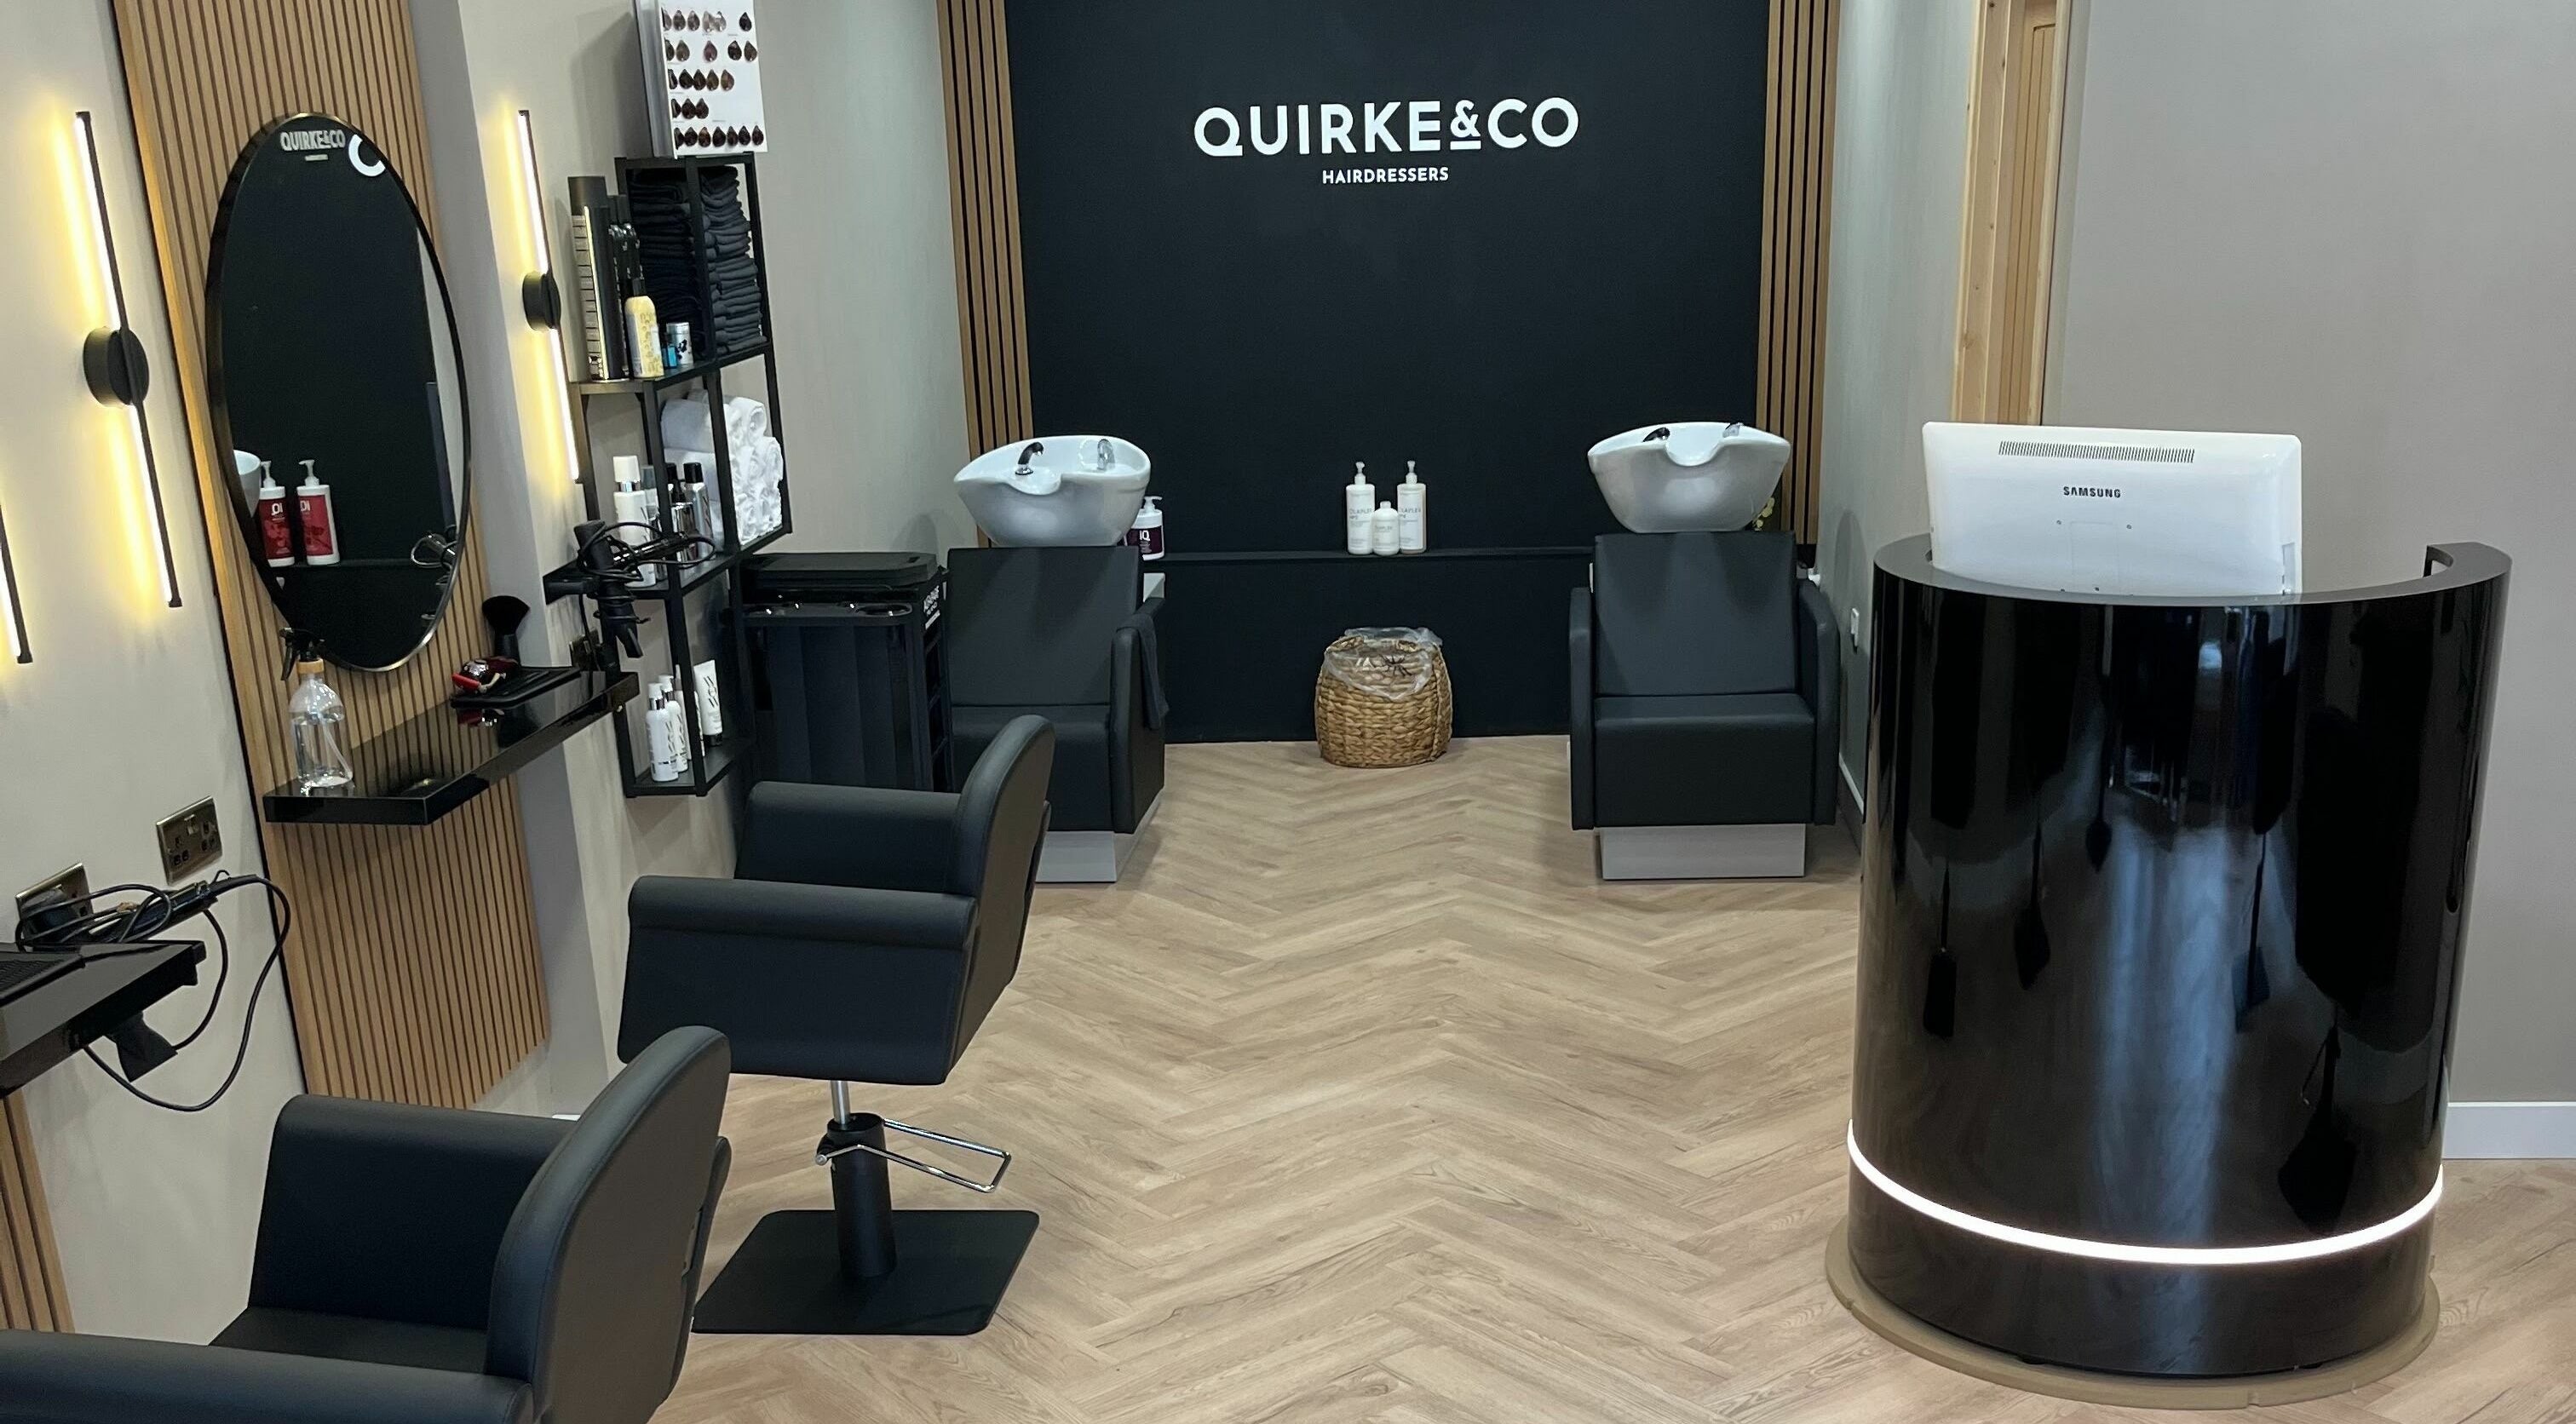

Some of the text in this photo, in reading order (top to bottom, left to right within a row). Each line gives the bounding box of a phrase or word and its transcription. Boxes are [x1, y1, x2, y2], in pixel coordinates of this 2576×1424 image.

[1193, 96, 1579, 157] QUIRKE&CO
[279, 129, 346, 152] QUIRKE&CO
[1322, 166, 1449, 184] HAIRDRESSERS
[2063, 485, 2121, 498] SAMSUNG
